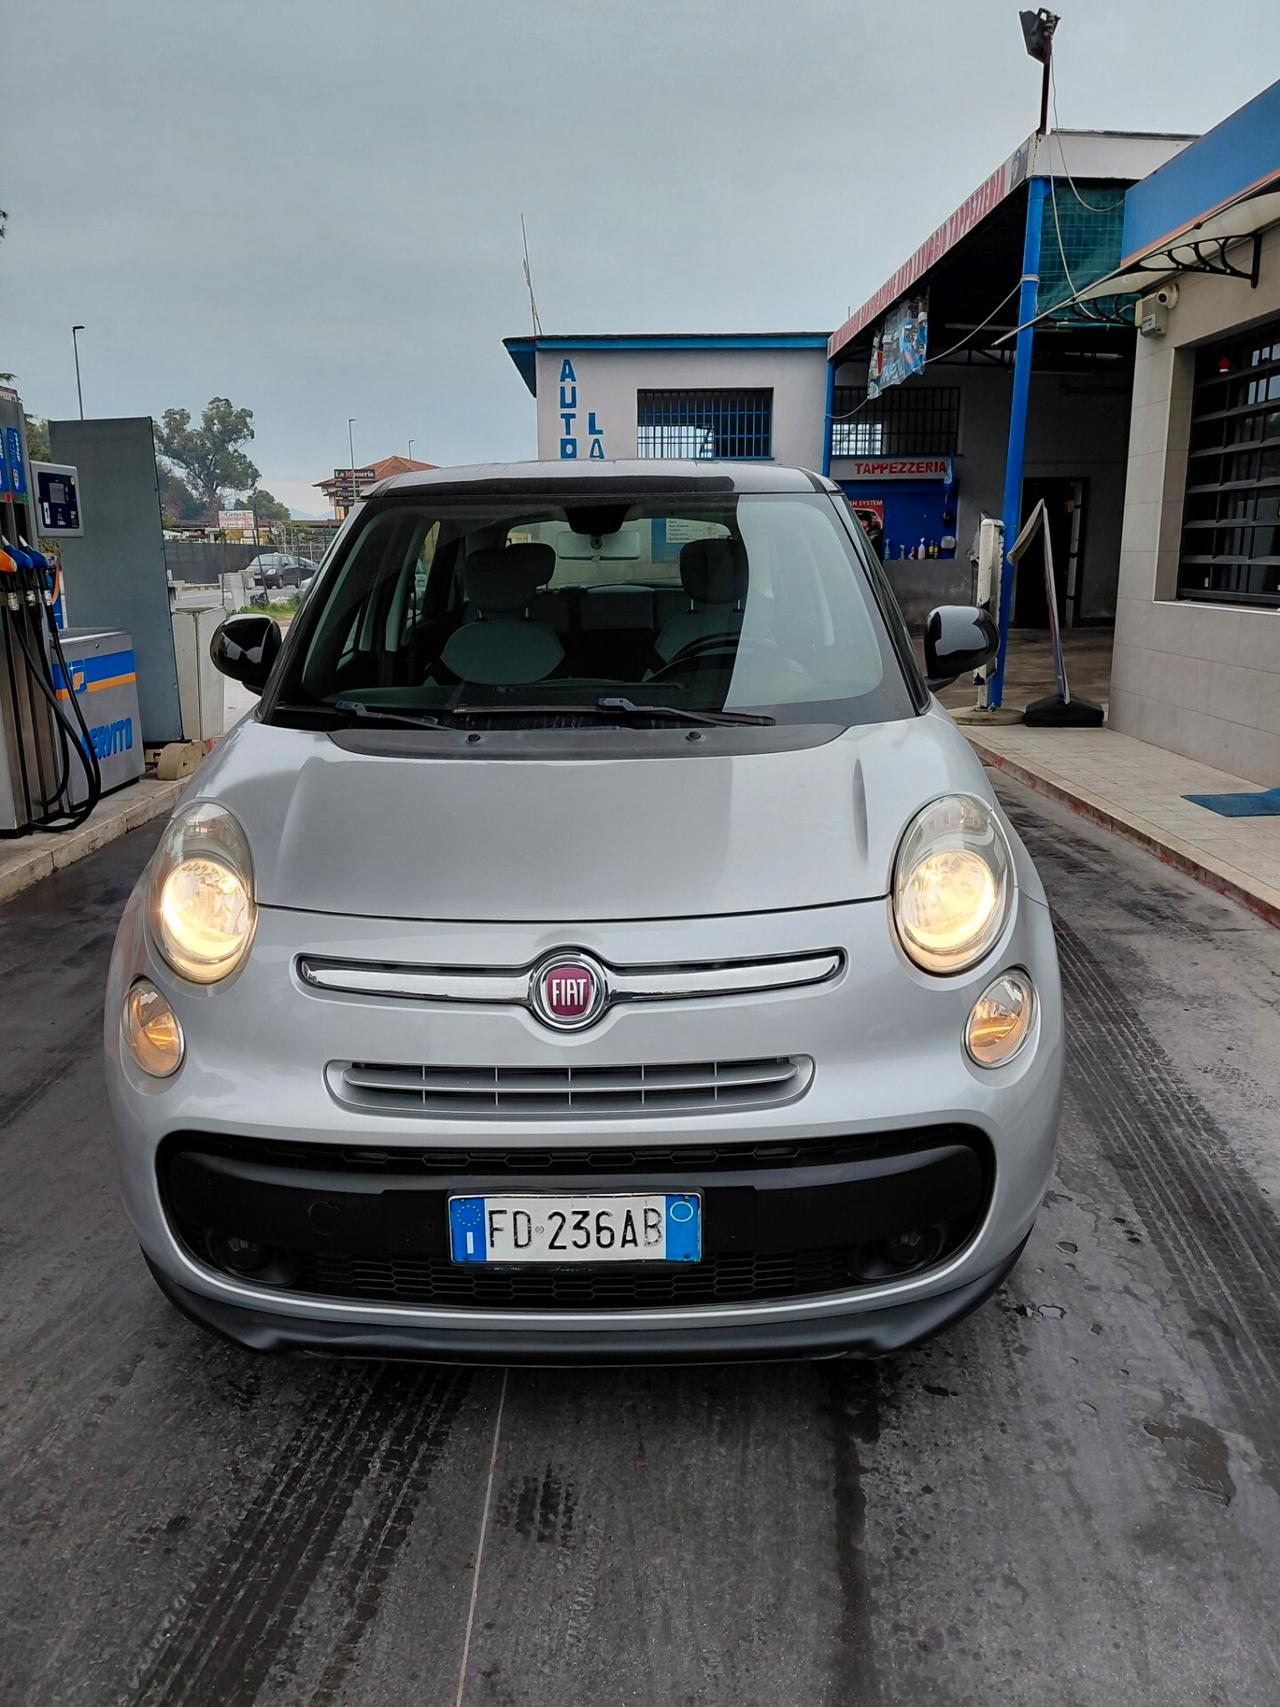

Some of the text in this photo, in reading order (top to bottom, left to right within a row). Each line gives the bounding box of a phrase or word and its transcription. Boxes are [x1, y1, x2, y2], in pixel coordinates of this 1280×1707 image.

[560, 358, 577, 459] AUTO
[855, 461, 947, 475] TAPPEZZERIA
[552, 978, 587, 1006] FIAT
[488, 1207, 662, 1250] FD 236AB
